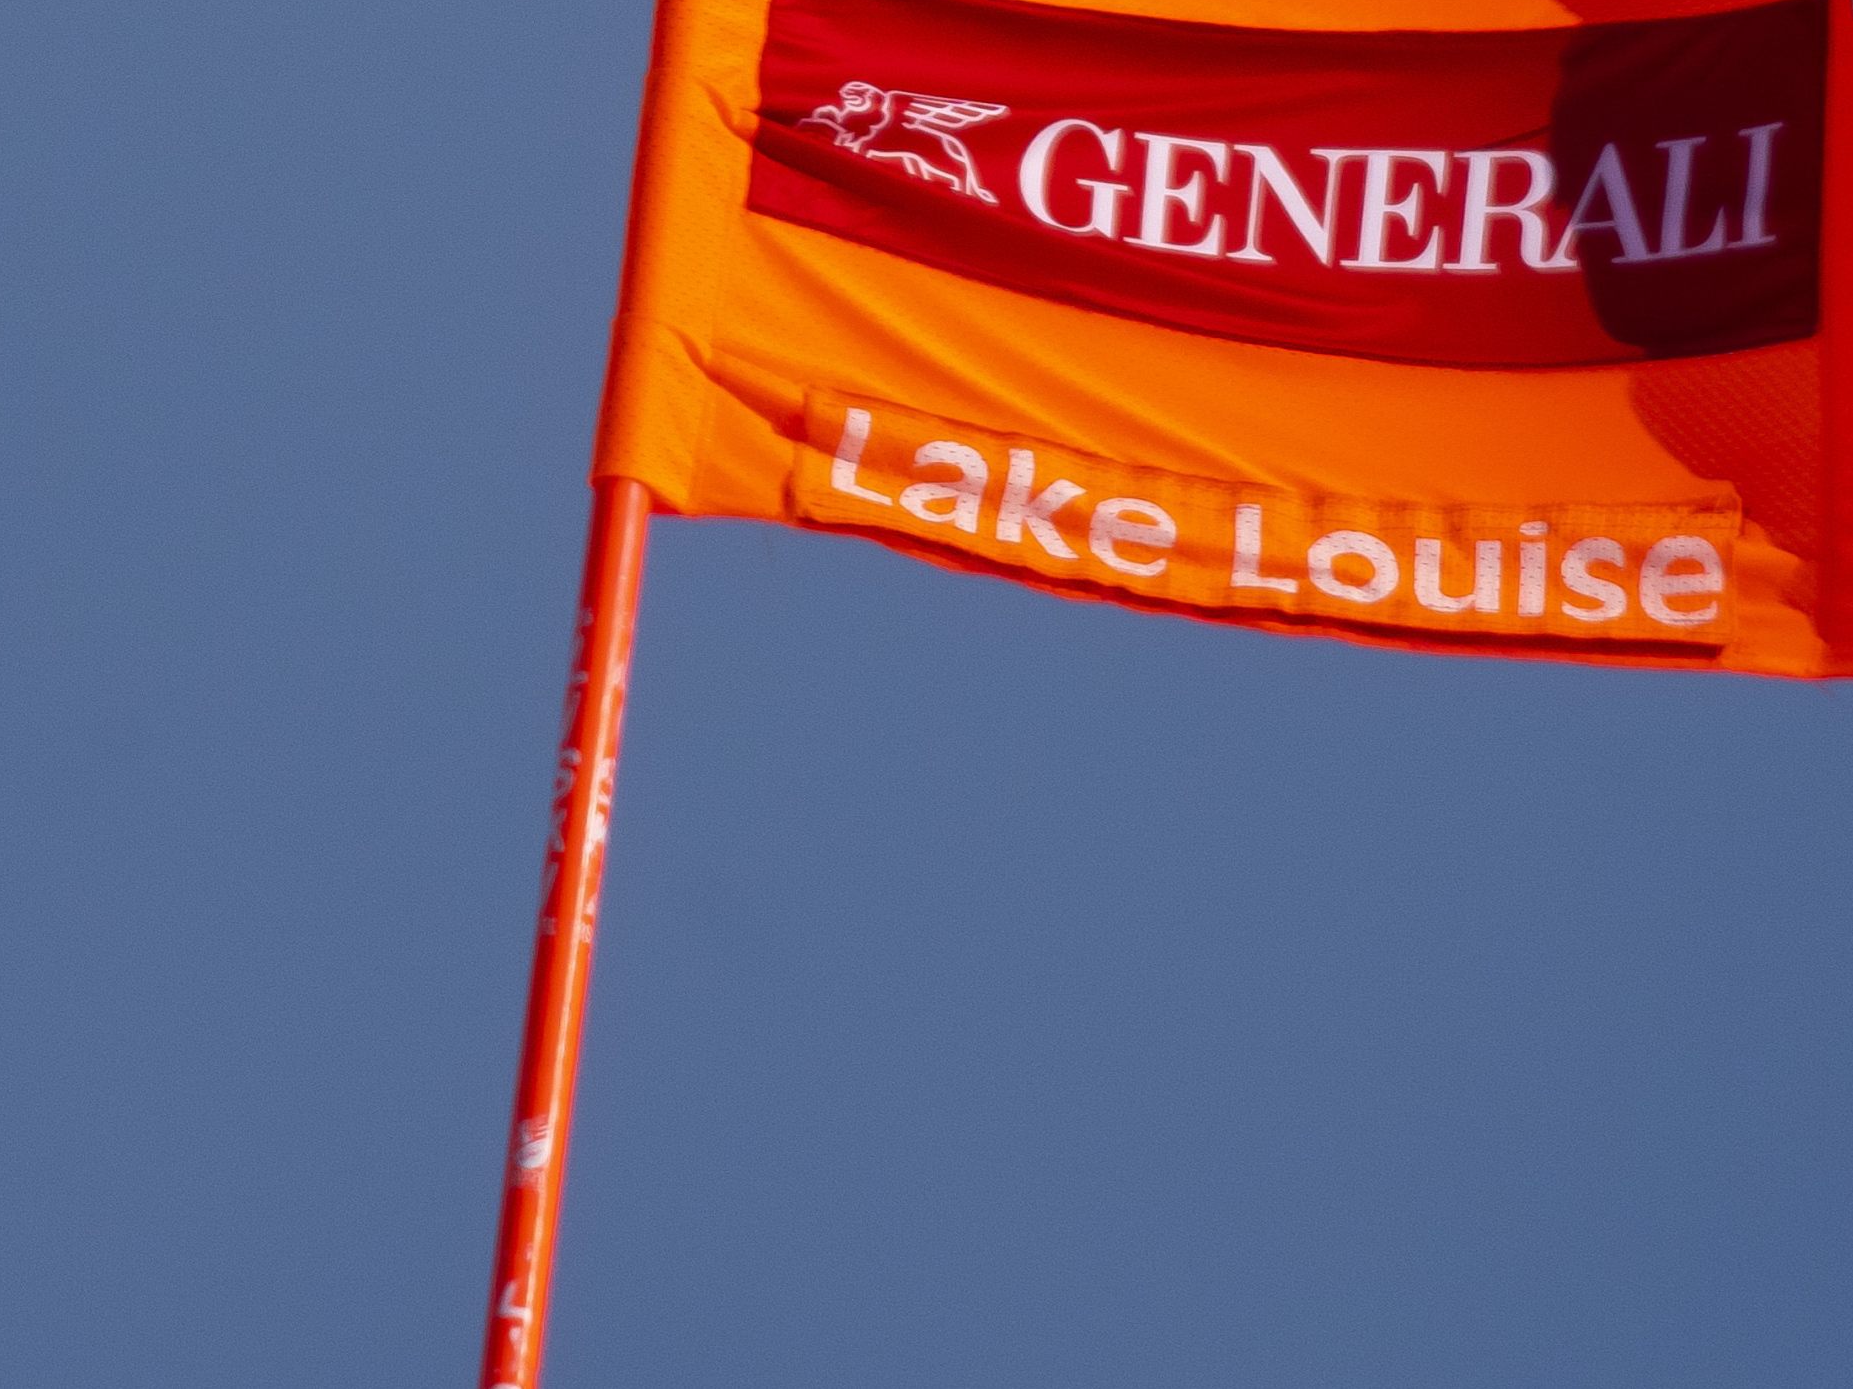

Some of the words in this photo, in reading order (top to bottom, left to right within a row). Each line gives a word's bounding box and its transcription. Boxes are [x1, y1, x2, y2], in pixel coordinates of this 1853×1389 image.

[1017, 118, 1788, 276] GENERALI
[830, 407, 1178, 578] Lake
[1229, 502, 1726, 628] Louise
